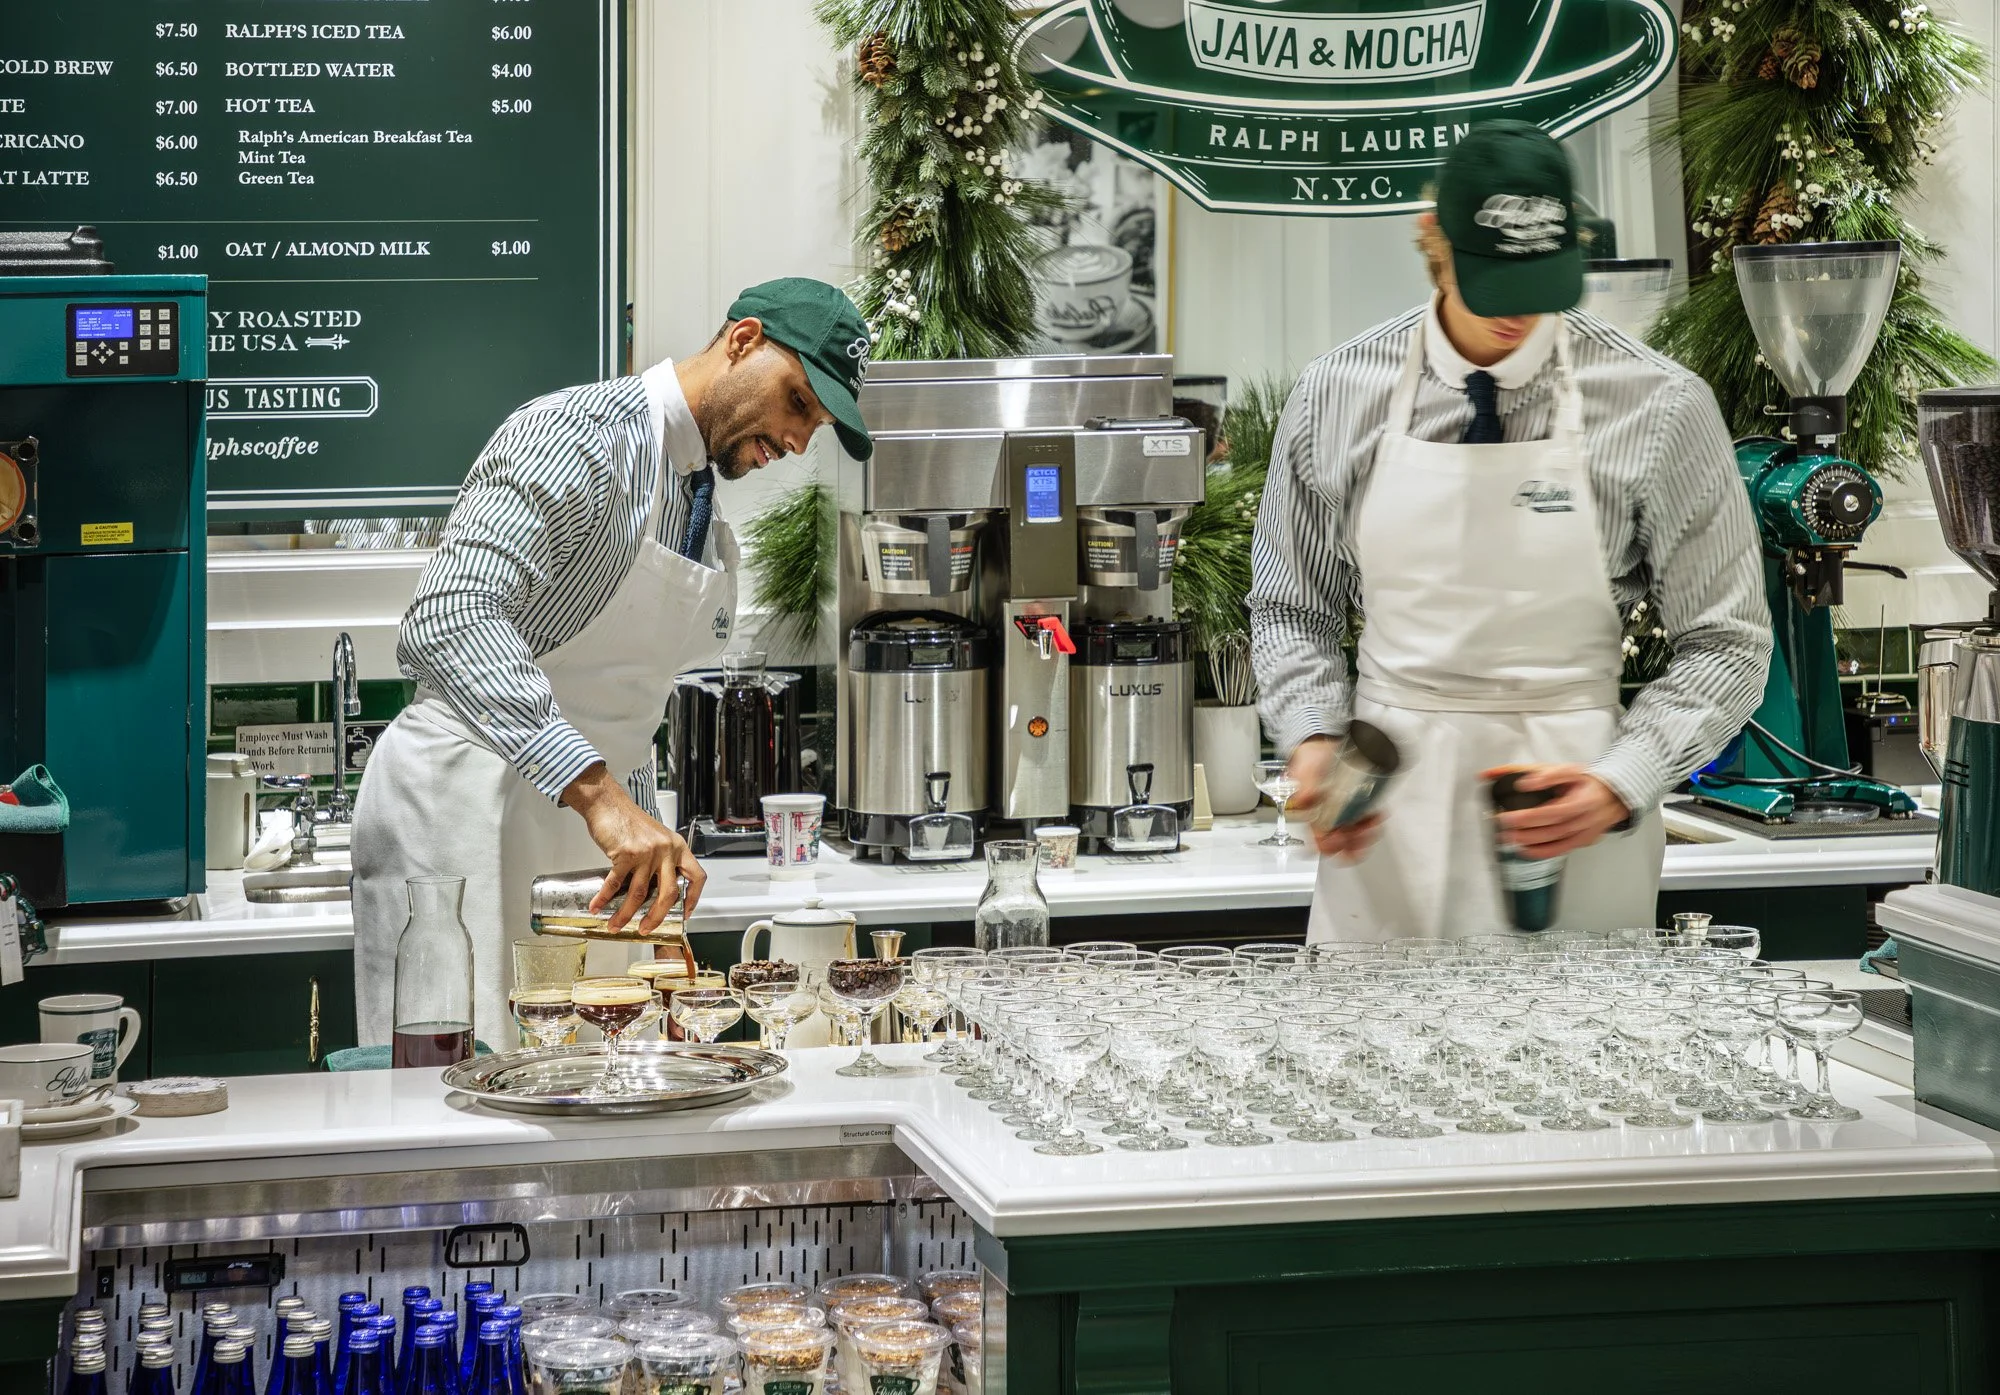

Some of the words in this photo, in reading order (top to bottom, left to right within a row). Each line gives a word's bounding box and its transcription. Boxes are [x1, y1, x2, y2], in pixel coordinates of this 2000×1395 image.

[156, 23, 198, 39] $7.50
[311, 24, 361, 39] ICED
[364, 24, 405, 39] TEA
[491, 25, 532, 41] $6.00
[1201, 18, 1299, 69] JAVA
[1308, 37, 1336, 67] &
[1344, 20, 1468, 70] MOCHA
[54, 60, 114, 76] BREW
[156, 62, 198, 77] $6.50
[225, 62, 321, 77] BOTTLED
[324, 62, 396, 78] WATER
[491, 64, 532, 79] $4.00
[156, 100, 198, 115] $7.00
[225, 98, 271, 113] HOT
[274, 98, 315, 113] TEA
[491, 99, 532, 114] $5.00
[0, 134, 85, 149] RICANO
[156, 135, 198, 150] $6.00
[298, 130, 369, 144] American
[373, 129, 443, 144] Breakfast
[445, 130, 473, 144] Tea
[1209, 124, 1319, 152] RALPH
[1340, 123, 1470, 152] LAUREN
[238, 151, 274, 164] Mint
[278, 151, 306, 164] Tea
[0, 170, 18, 185] T
[22, 171, 90, 186] LATTE
[156, 171, 198, 187] $6.50
[238, 171, 283, 185] Green
[287, 171, 315, 185] Tea
[1291, 176, 1403, 201] N.Y.C.
[157, 244, 199, 260] $1.00
[225, 242, 267, 257] OAT
[286, 241, 375, 257] ALMOND
[379, 241, 431, 256] MILK
[491, 240, 531, 257] $1.00
[209, 311, 232, 329] Y
[238, 310, 362, 329] ROASTED
[241, 334, 299, 352] USA
[245, 386, 341, 409] TASTING
[206, 436, 319, 461] lphscoffee
[1151, 439, 1183, 449] XTS
[1109, 683, 1162, 697] LUXUS
[239, 733, 280, 745] Employee
[281, 731, 303, 742] Must
[306, 730, 328, 740] Wash
[239, 746, 266, 757] Hands
[268, 745, 295, 756] Before
[297, 744, 334, 755] Returnin
[251, 761, 275, 771] Work
